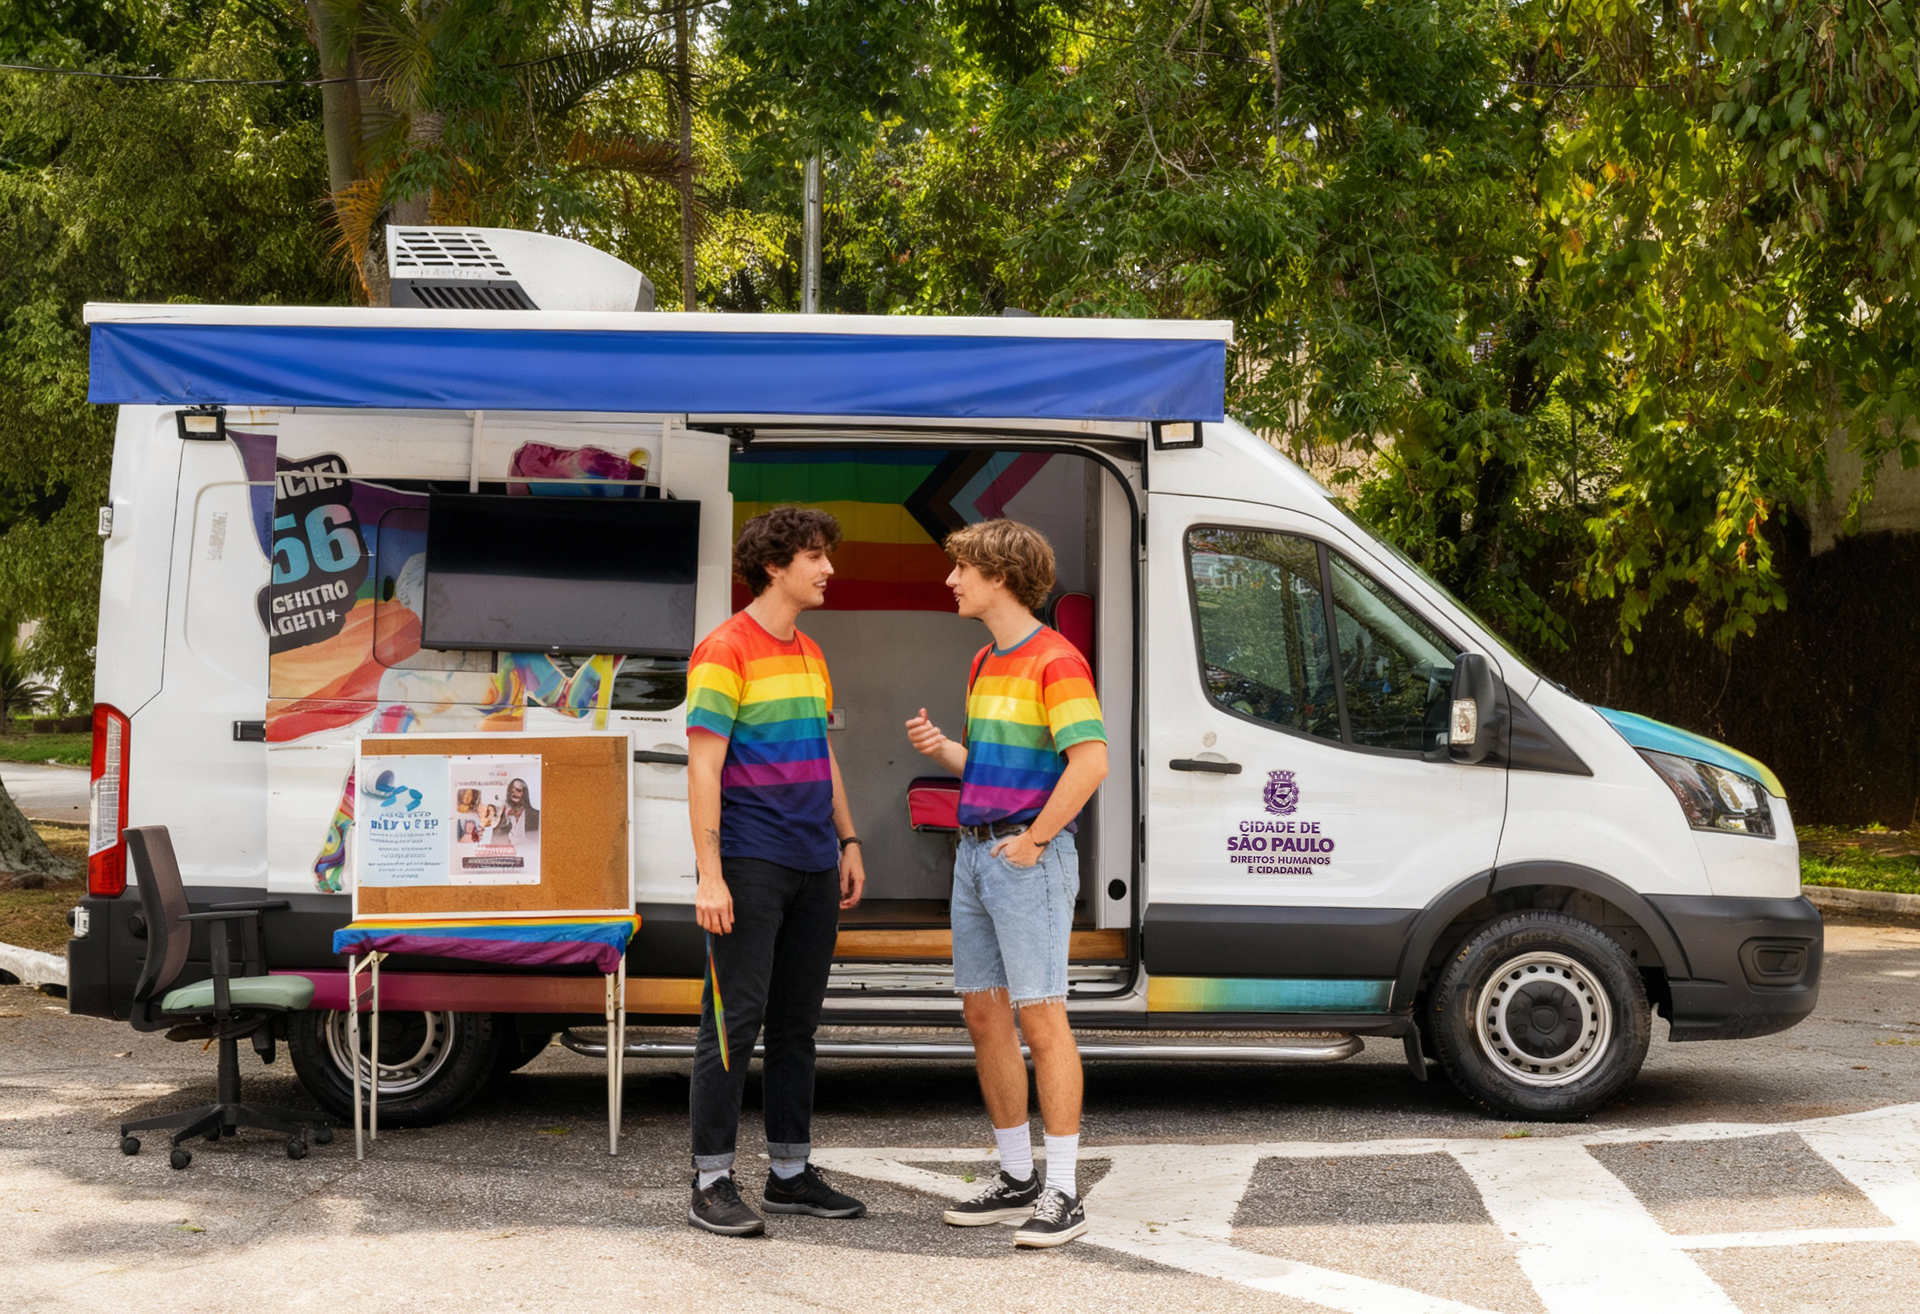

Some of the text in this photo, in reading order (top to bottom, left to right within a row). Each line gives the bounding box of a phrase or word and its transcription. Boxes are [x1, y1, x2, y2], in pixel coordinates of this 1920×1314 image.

[273, 503, 361, 585] 56
[1239, 820, 1321, 834] CIDADE DE
[1227, 833, 1335, 853] SÃO PAULO
[1230, 855, 1331, 865] DIREITOS HUMANOS
[1248, 865, 1313, 875] E CIDADANIA
